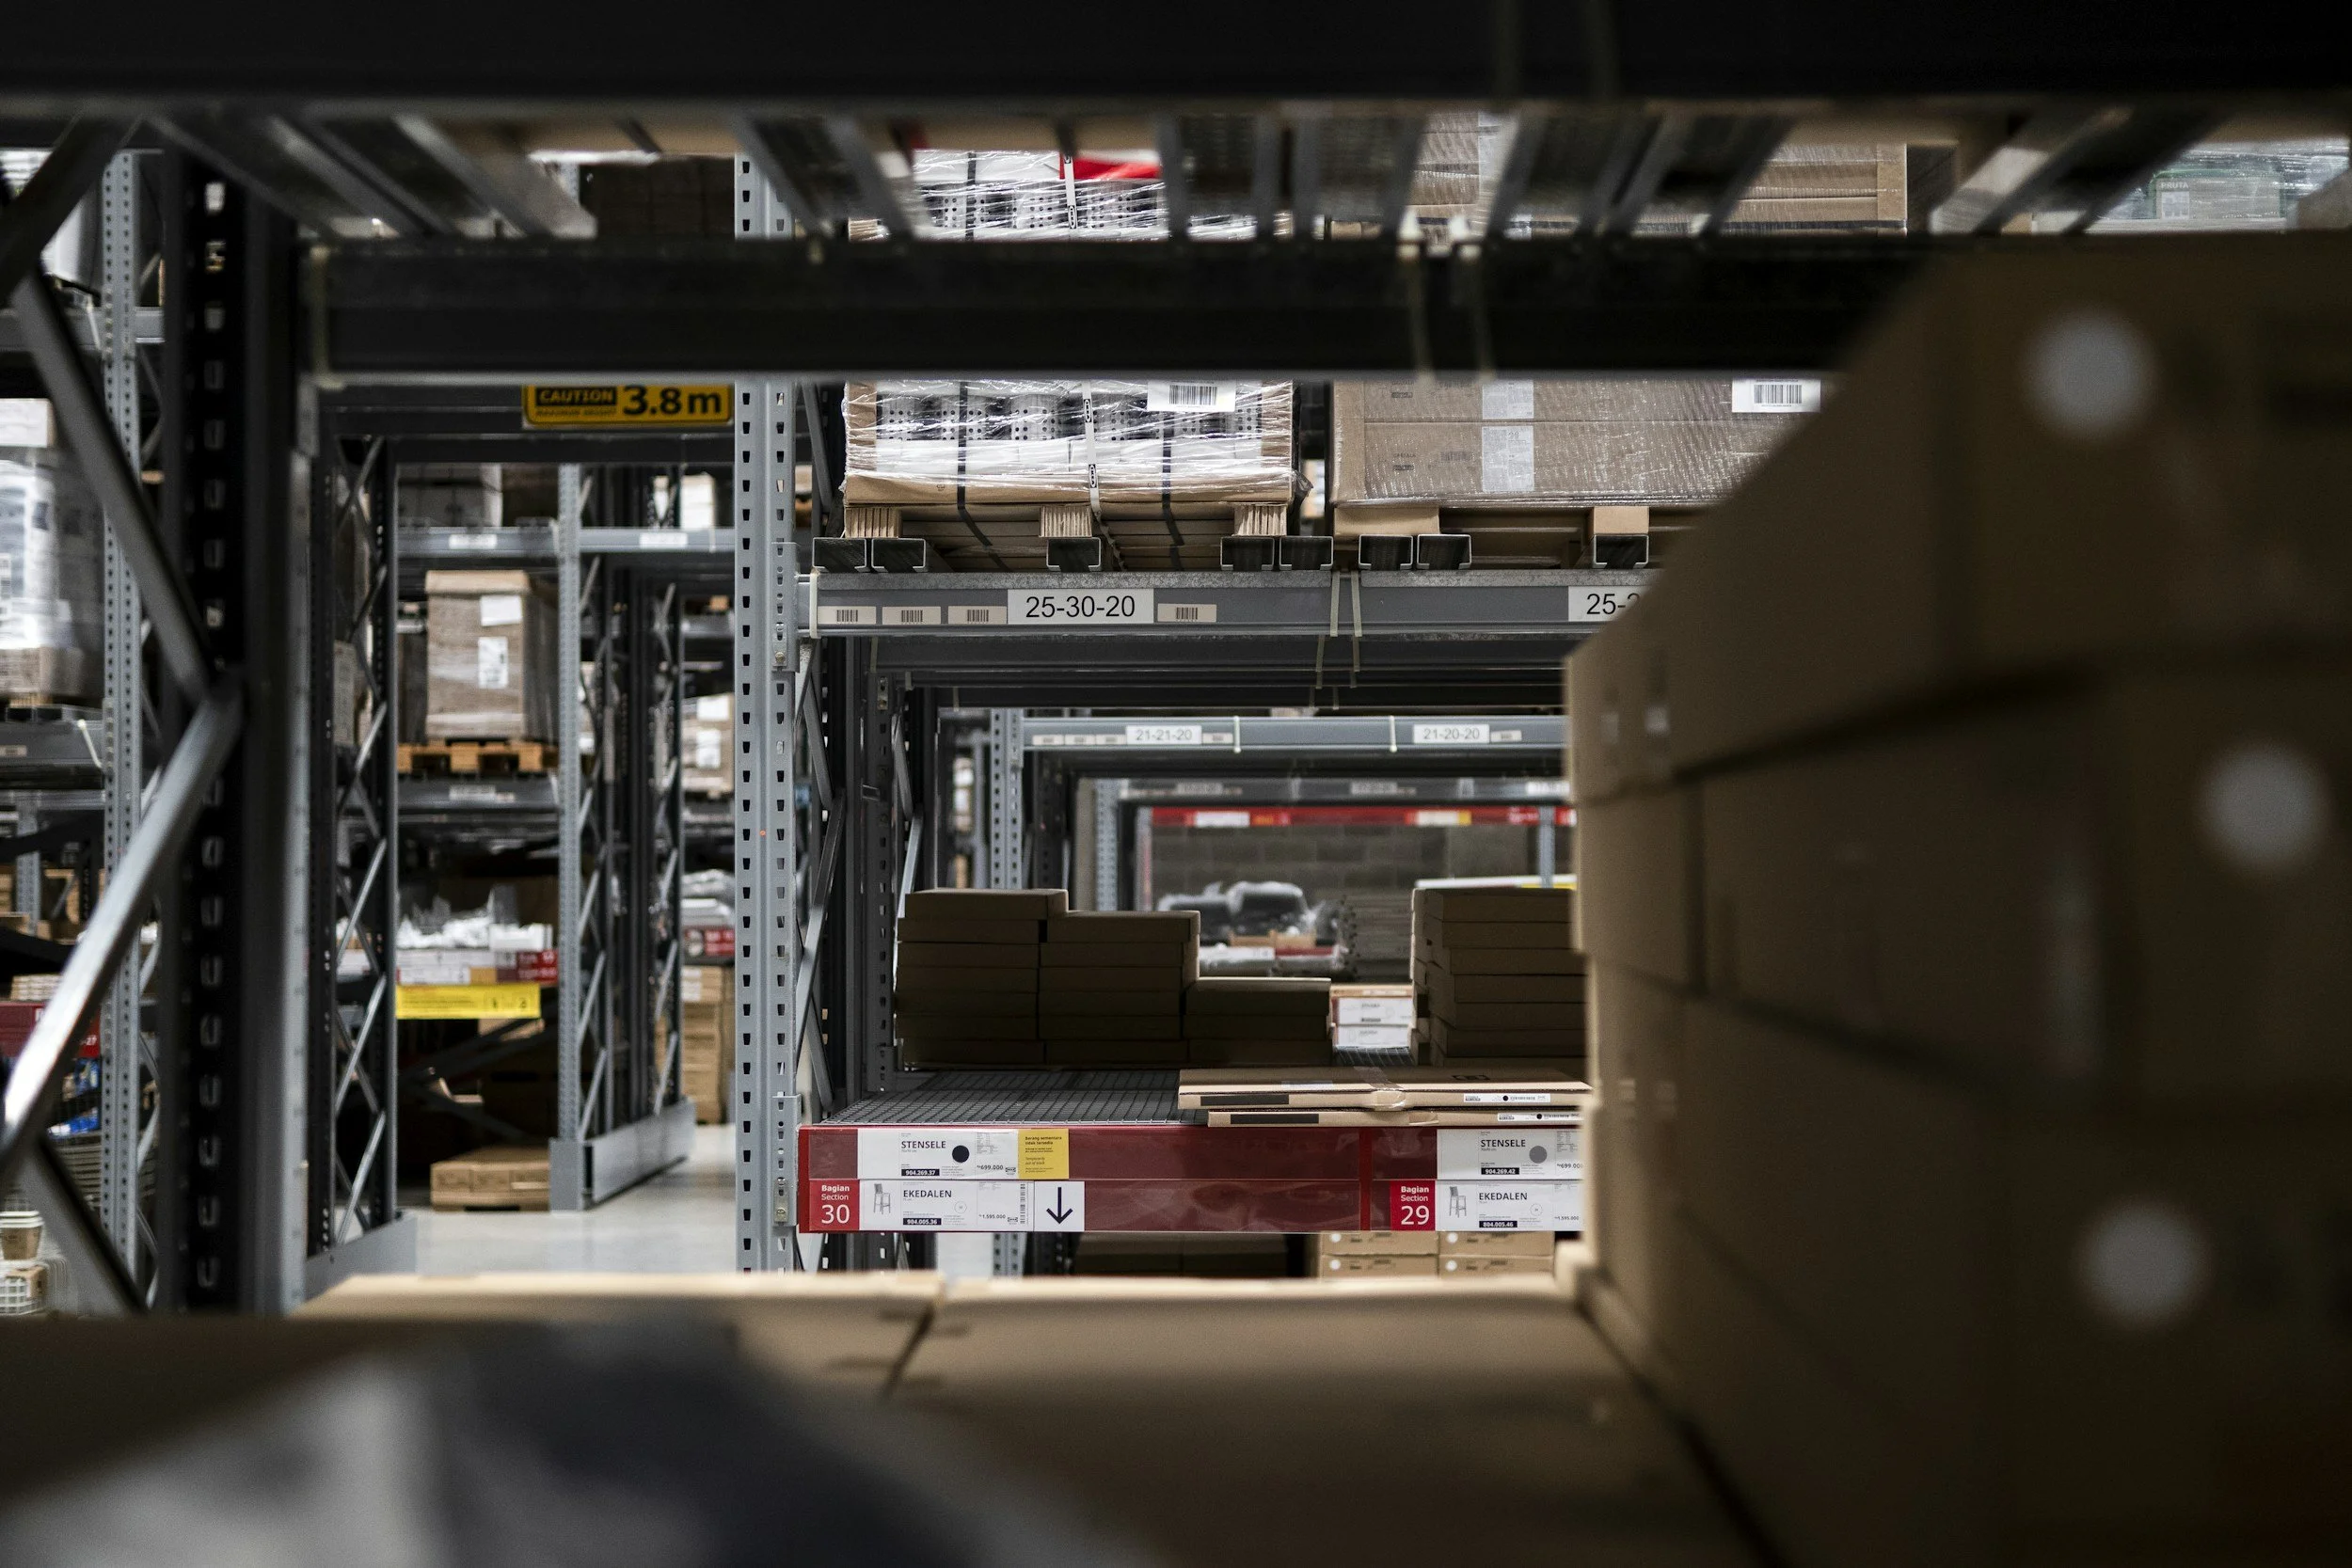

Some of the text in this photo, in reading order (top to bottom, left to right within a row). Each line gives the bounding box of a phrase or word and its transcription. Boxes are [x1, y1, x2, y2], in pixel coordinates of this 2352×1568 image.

[2160, 181, 2189, 189] PRUTA
[538, 388, 612, 404] CAUTION
[1025, 595, 1136, 618] 25-30-20
[1136, 730, 1192, 741] 21-21-20
[1423, 728, 1480, 740] 21-20-20
[901, 1140, 946, 1148] STENSELE
[1480, 1139, 1526, 1148] STENSELE
[821, 1184, 850, 1193] Bagian
[1401, 1185, 1430, 1194] Bagian
[1479, 1192, 1528, 1200] EKEDALEN
[821, 1204, 850, 1224] 30
[1401, 1205, 1430, 1226] 29
